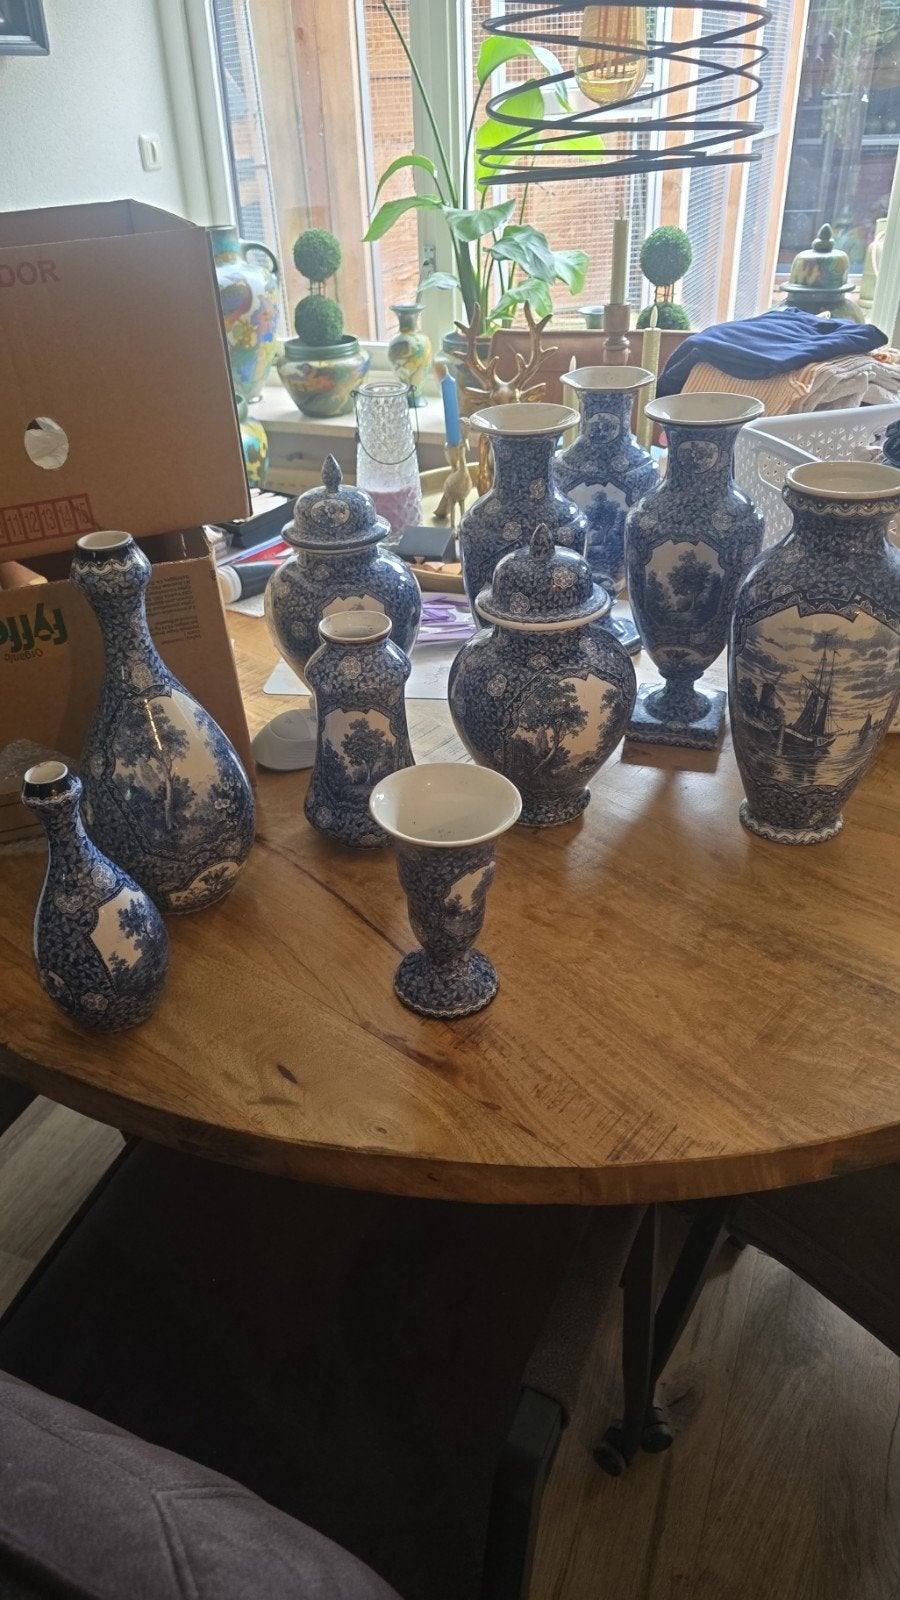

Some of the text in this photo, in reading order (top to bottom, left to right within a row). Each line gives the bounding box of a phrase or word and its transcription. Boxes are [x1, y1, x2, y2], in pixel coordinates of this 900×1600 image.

[6, 513, 24, 537] 11
[23, 510, 41, 533] 12
[40, 508, 57, 531] 13
[57, 505, 73, 527] 14
[73, 502, 90, 524] 15
[4, 648, 43, 664] Organic
